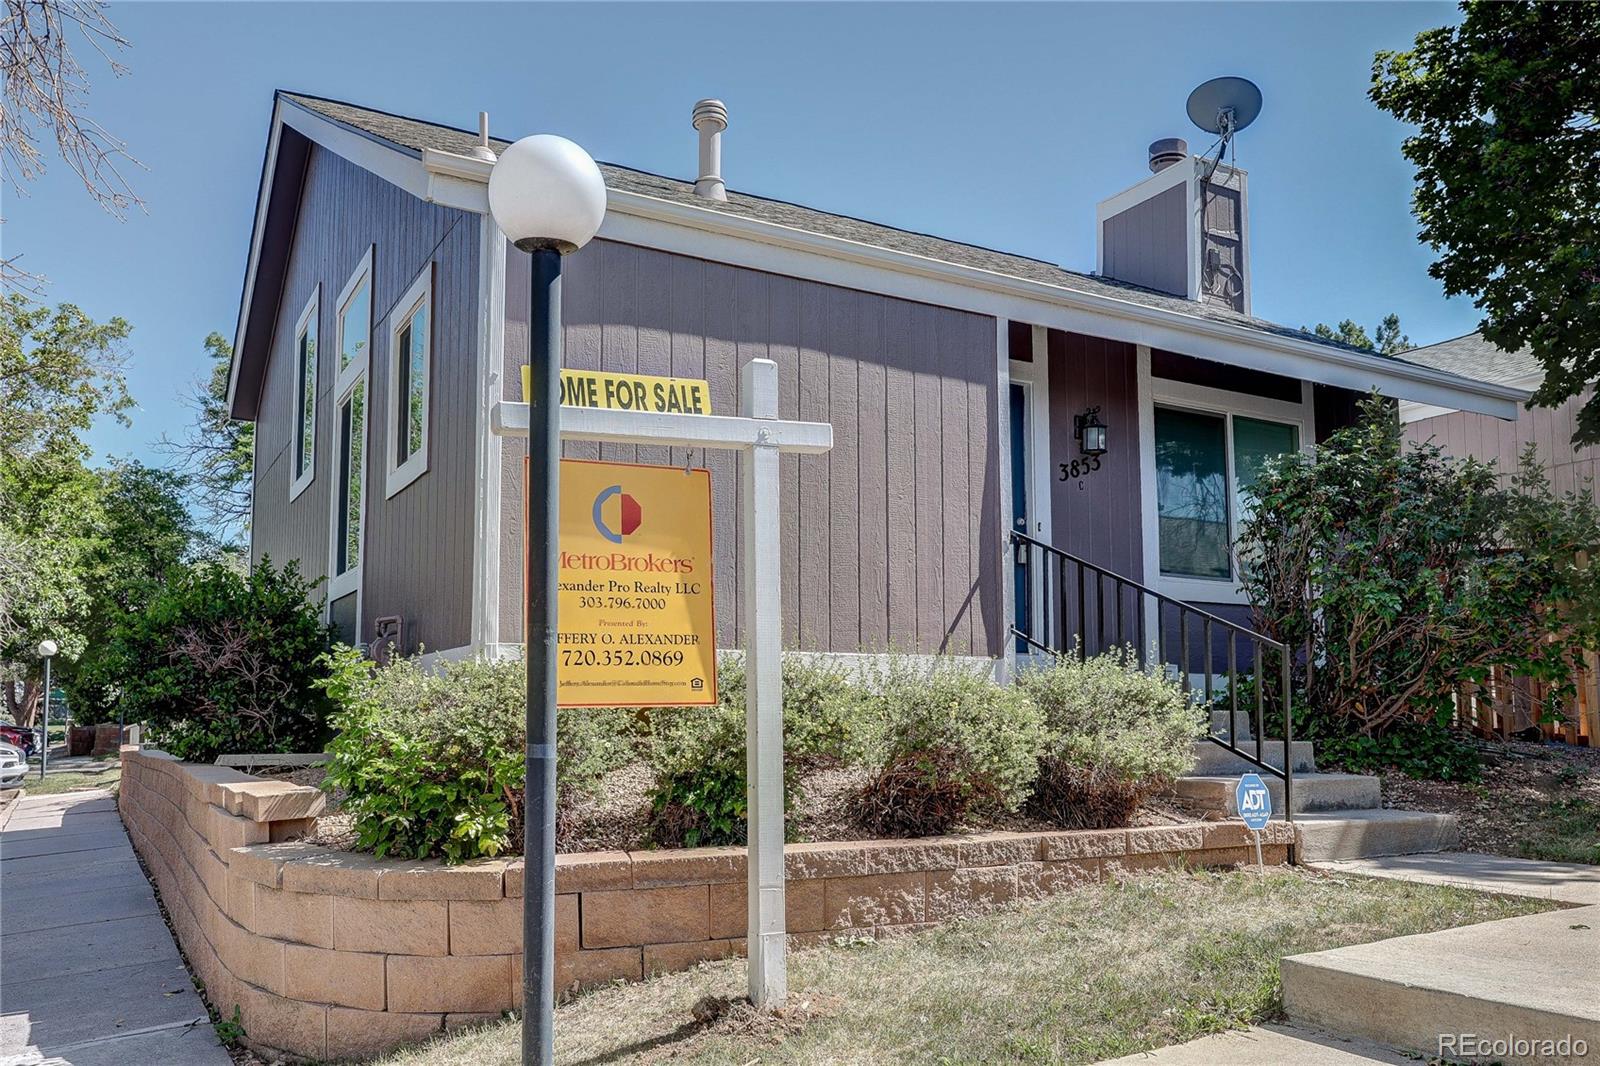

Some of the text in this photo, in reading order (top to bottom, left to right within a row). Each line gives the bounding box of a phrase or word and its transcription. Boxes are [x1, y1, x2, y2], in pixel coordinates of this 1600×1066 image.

[560, 376, 702, 414] ME FOR SALE
[1059, 455, 1101, 482] 3853
[558, 580, 701, 596] exander Pro Realty LLC
[579, 597, 666, 610] 303.796.7000
[599, 619, 634, 628] Presented
[557, 633, 700, 645] FFERY O. ALEXANDER
[562, 651, 684, 666] 720.352.0869
[1242, 789, 1265, 810] ADT
